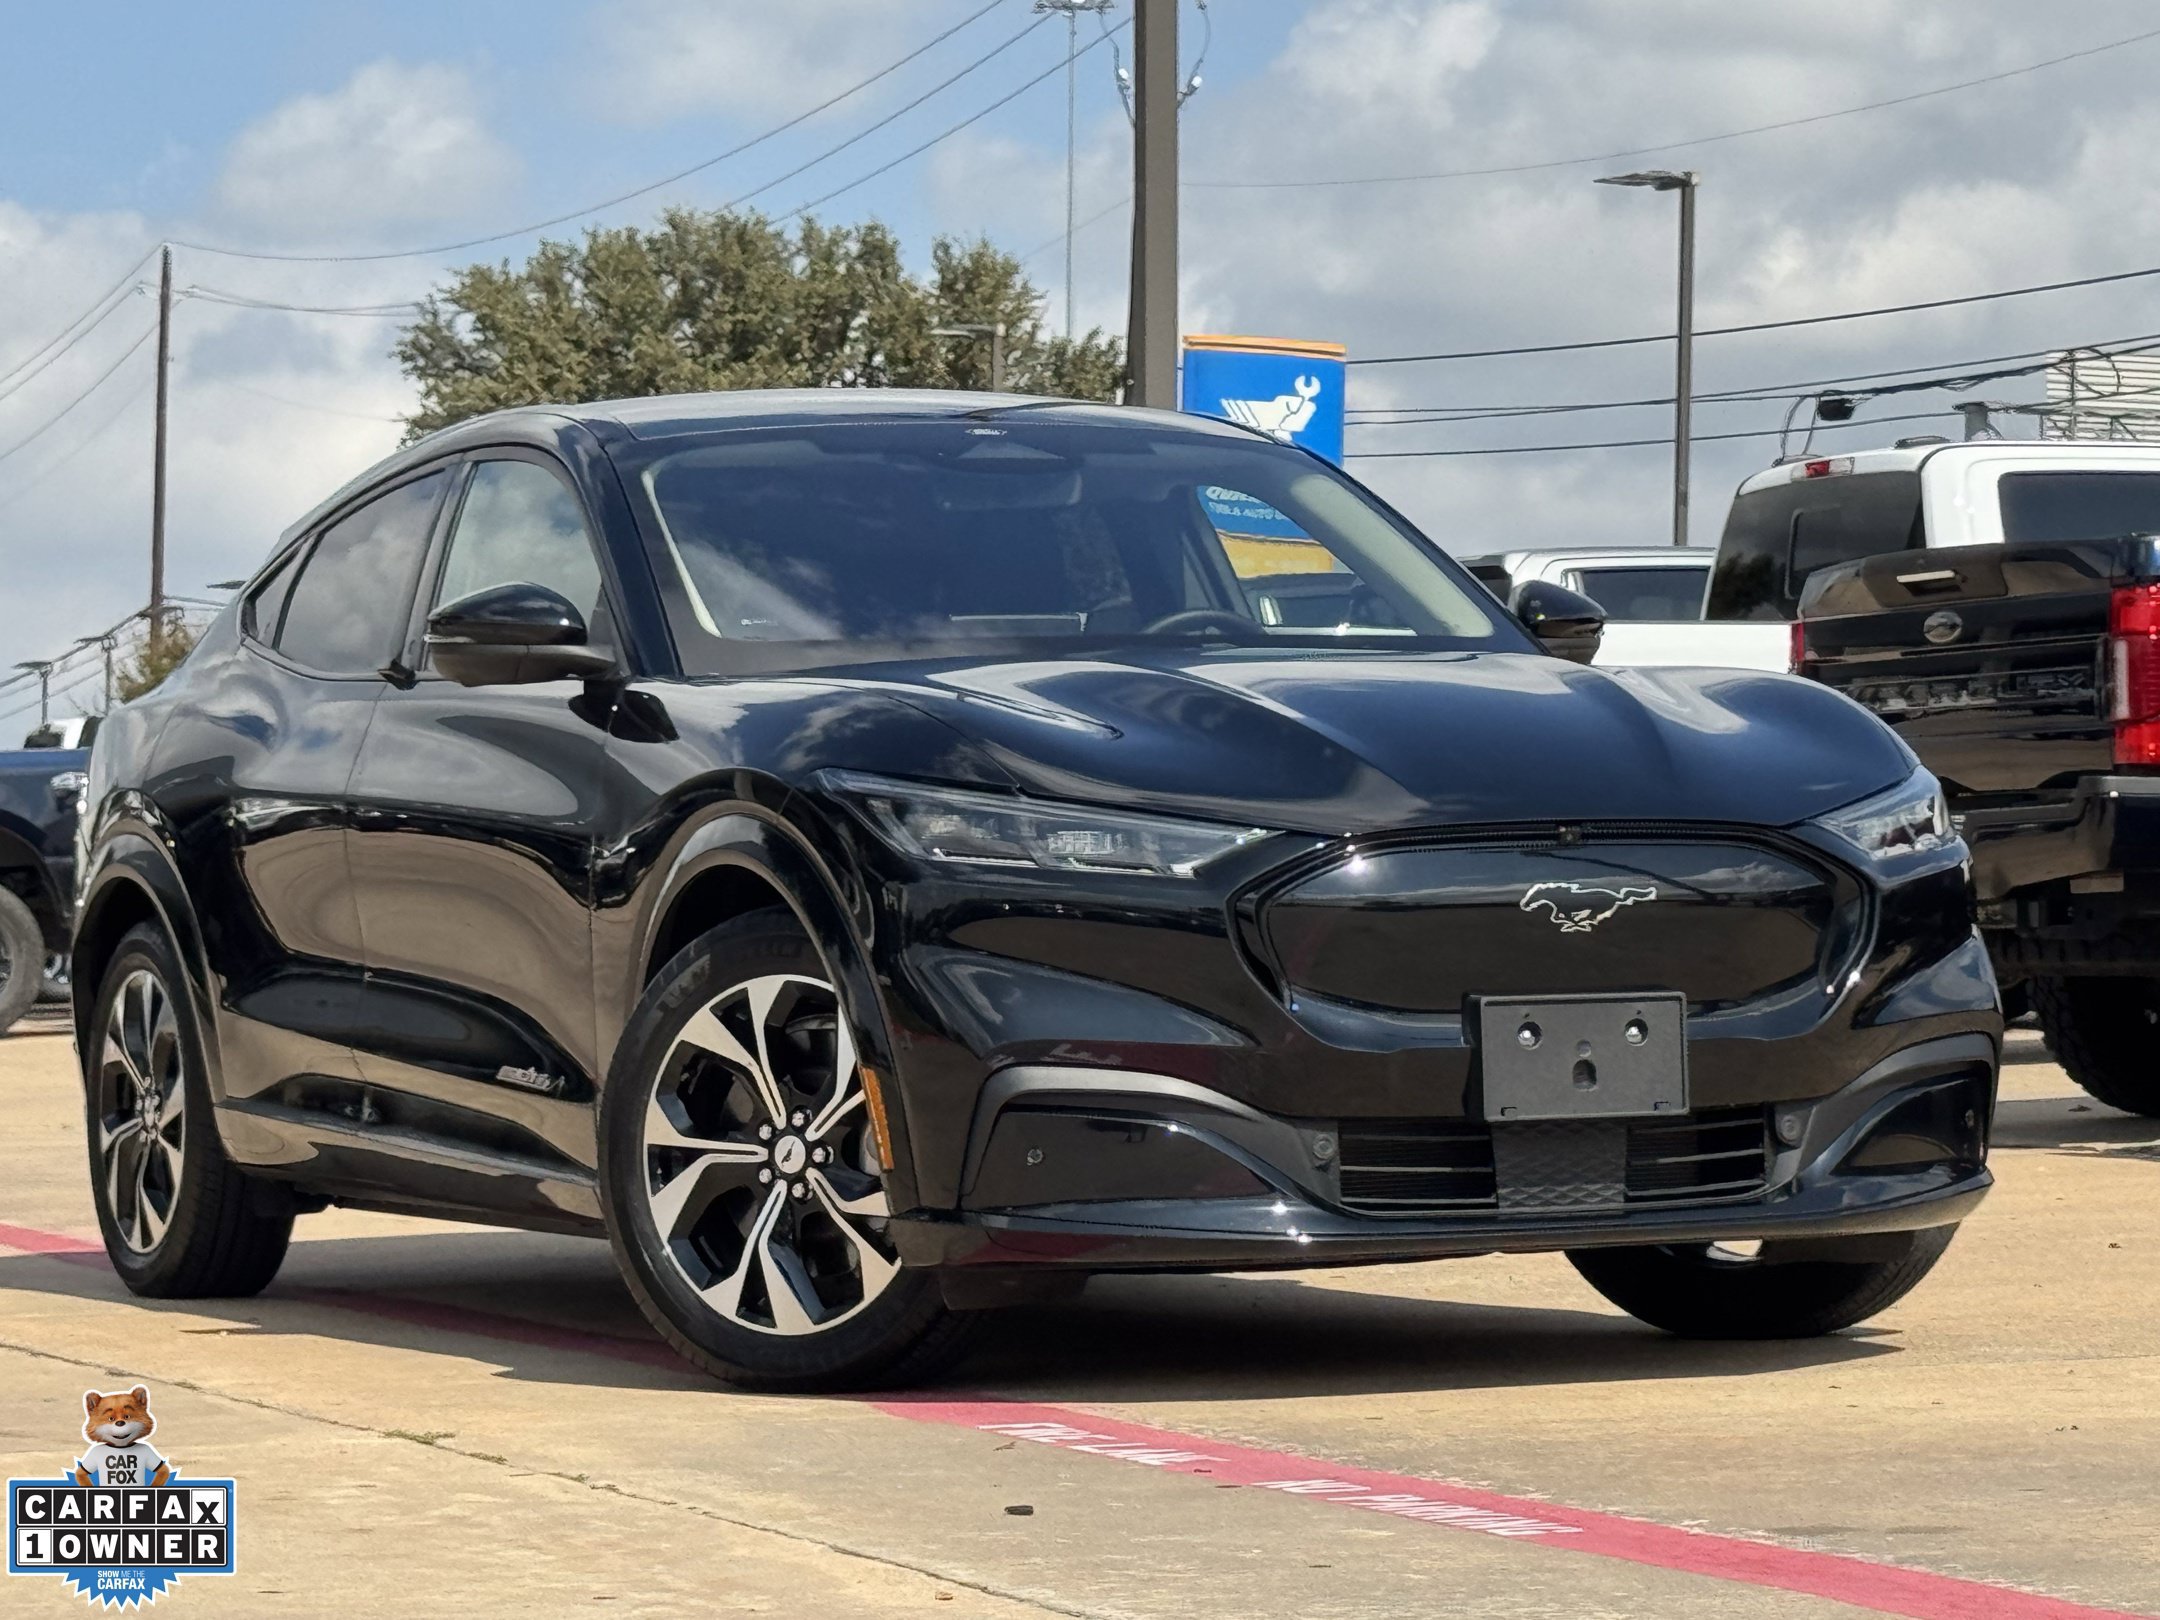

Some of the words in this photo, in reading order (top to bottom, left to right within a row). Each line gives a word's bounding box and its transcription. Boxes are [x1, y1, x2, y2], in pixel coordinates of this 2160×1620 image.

[1067, 1442, 1232, 1465] LANE
[1250, 1479, 1372, 1494] NO
[1326, 1494, 1584, 1536] PARKING
